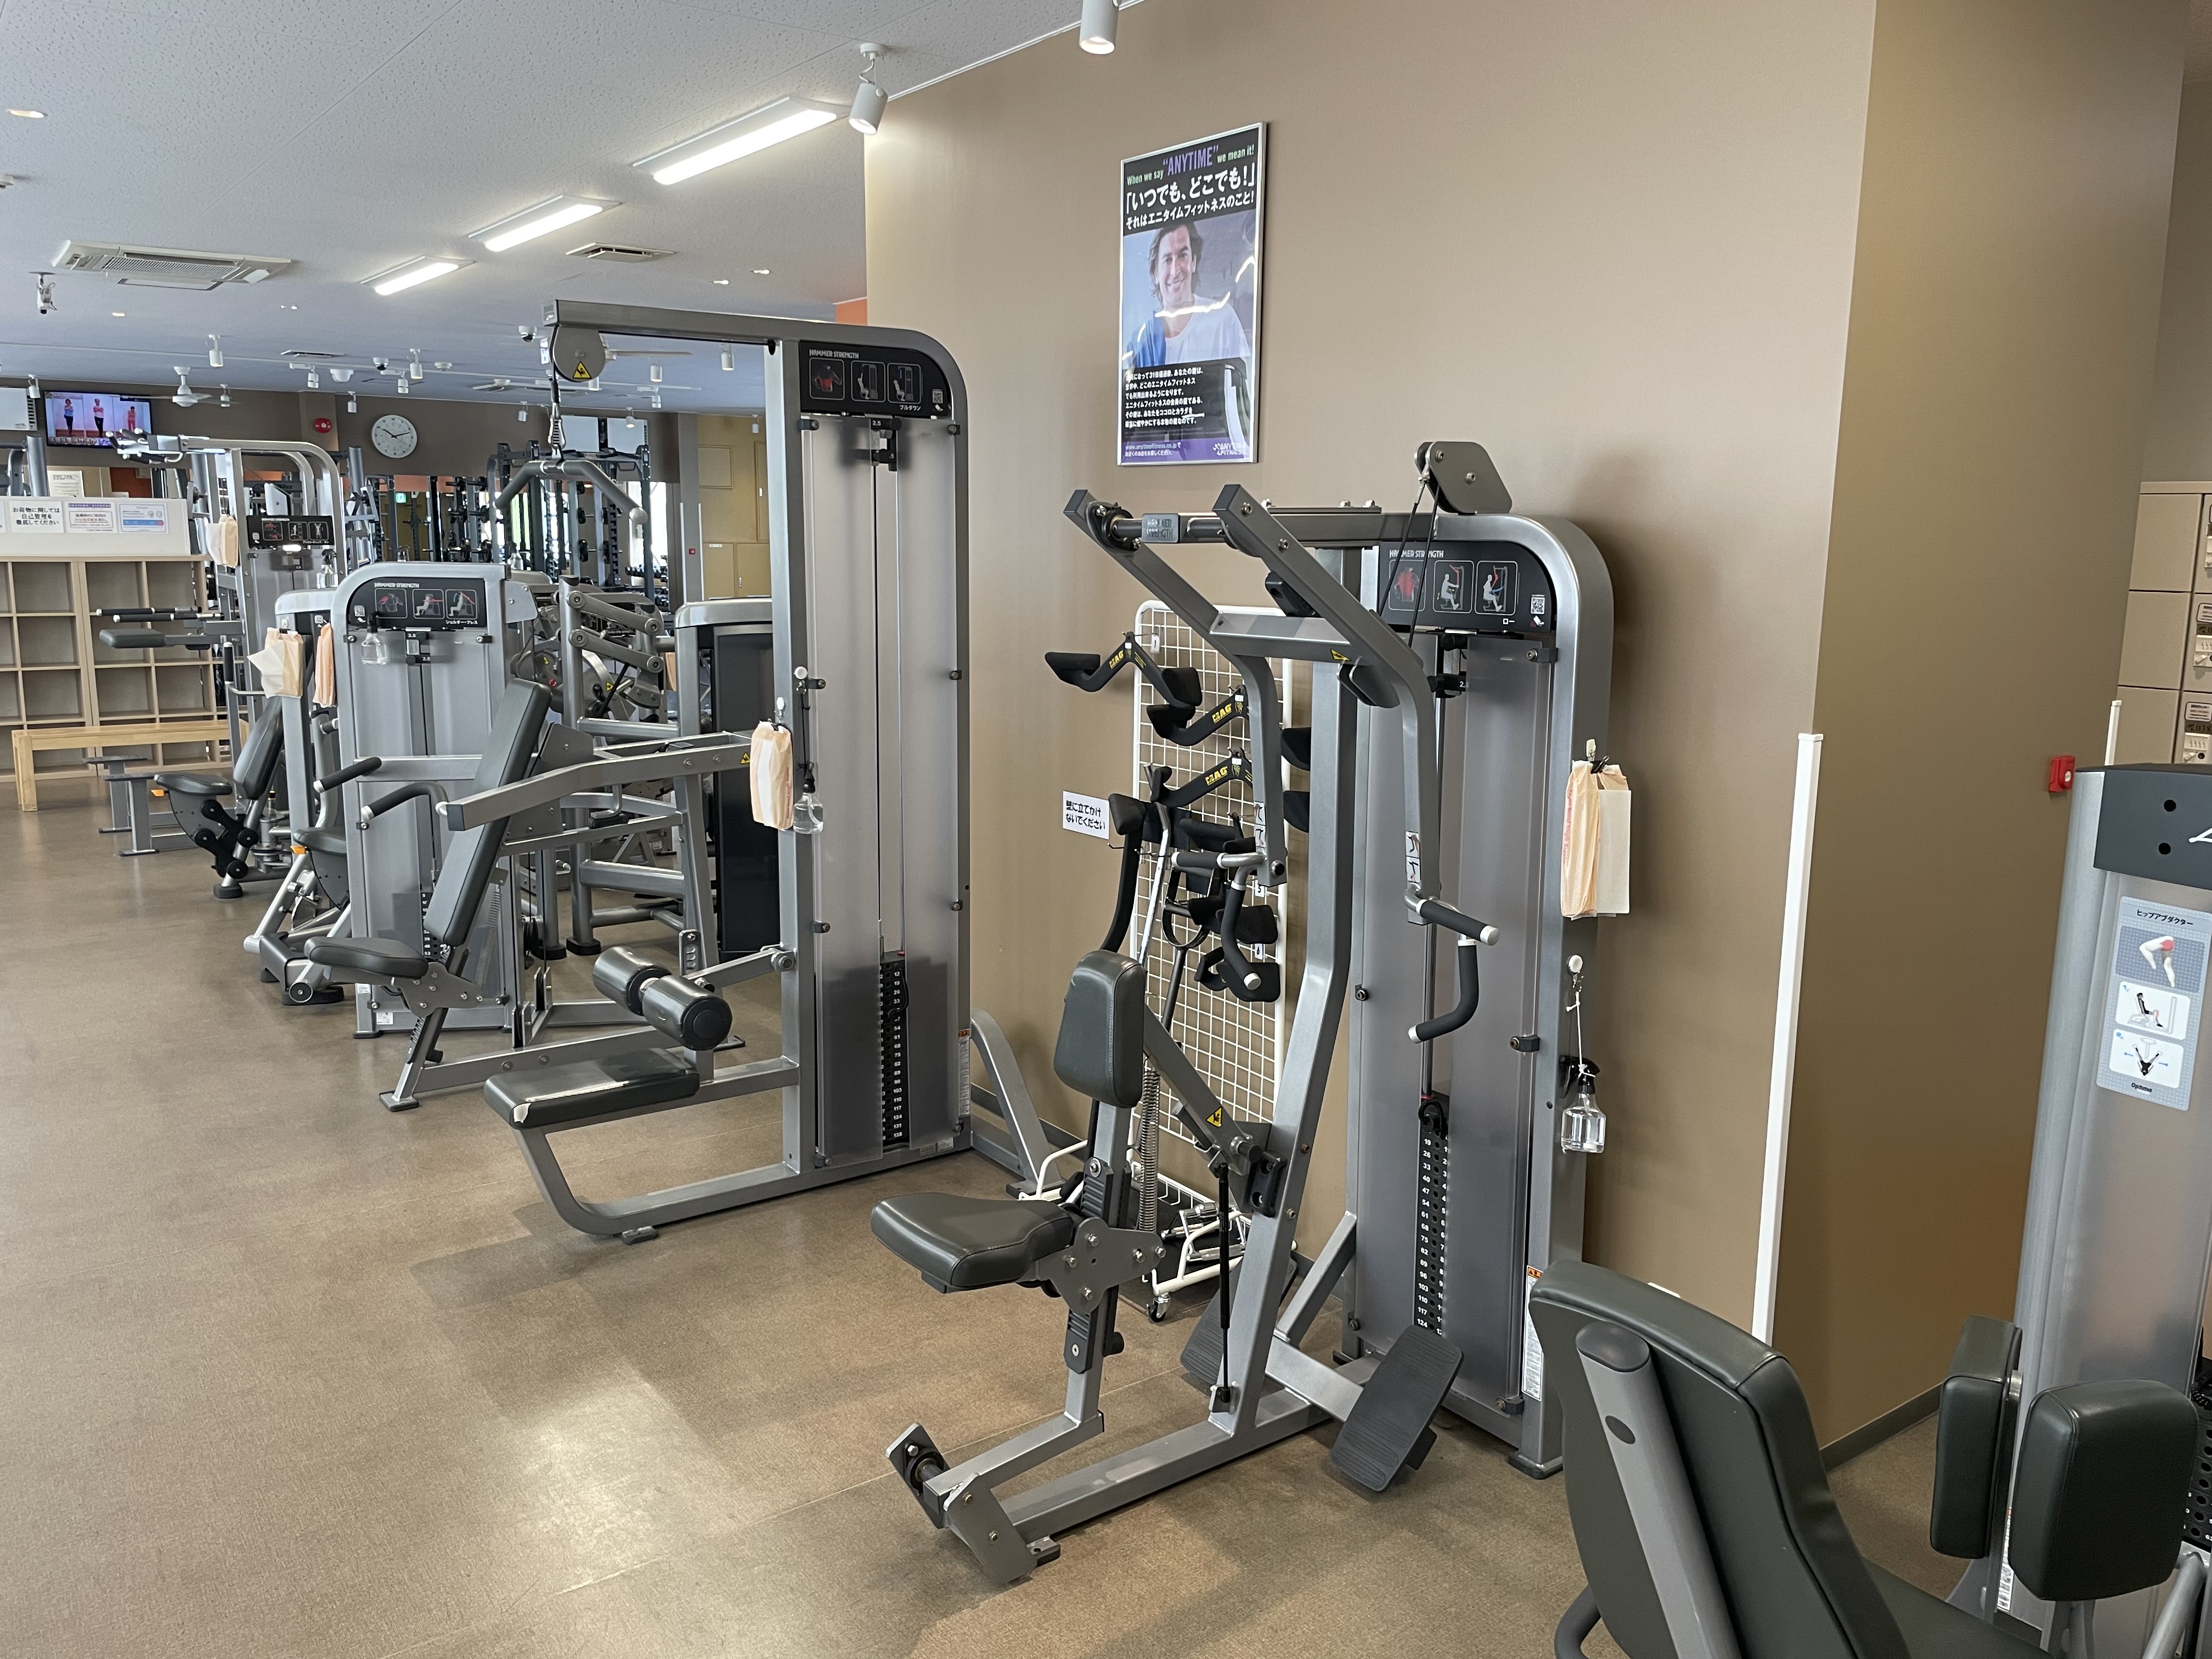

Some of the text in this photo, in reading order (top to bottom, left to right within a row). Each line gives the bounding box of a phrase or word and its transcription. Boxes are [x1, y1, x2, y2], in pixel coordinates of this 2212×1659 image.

[1126, 174, 1142, 186] When
[1153, 169, 1164, 180] say
[1217, 154, 1226, 163] we
[1228, 150, 1245, 161] mean
[809, 349, 833, 357] HAMMER
[2136, 909, 2193, 927] ヒップアブダクター
[1423, 1150, 1431, 1158] 26
[1421, 1199, 1430, 1207] 54
[1421, 1211, 1429, 1219] 61
[1420, 1235, 1429, 1243] 75
[1420, 1247, 1429, 1256] 82
[1419, 1271, 1427, 1279] 96
[1418, 1283, 1429, 1292] 103
[1418, 1295, 1428, 1304] 110
[1418, 1307, 1427, 1316] 117
[1417, 1318, 1428, 1328] 124
